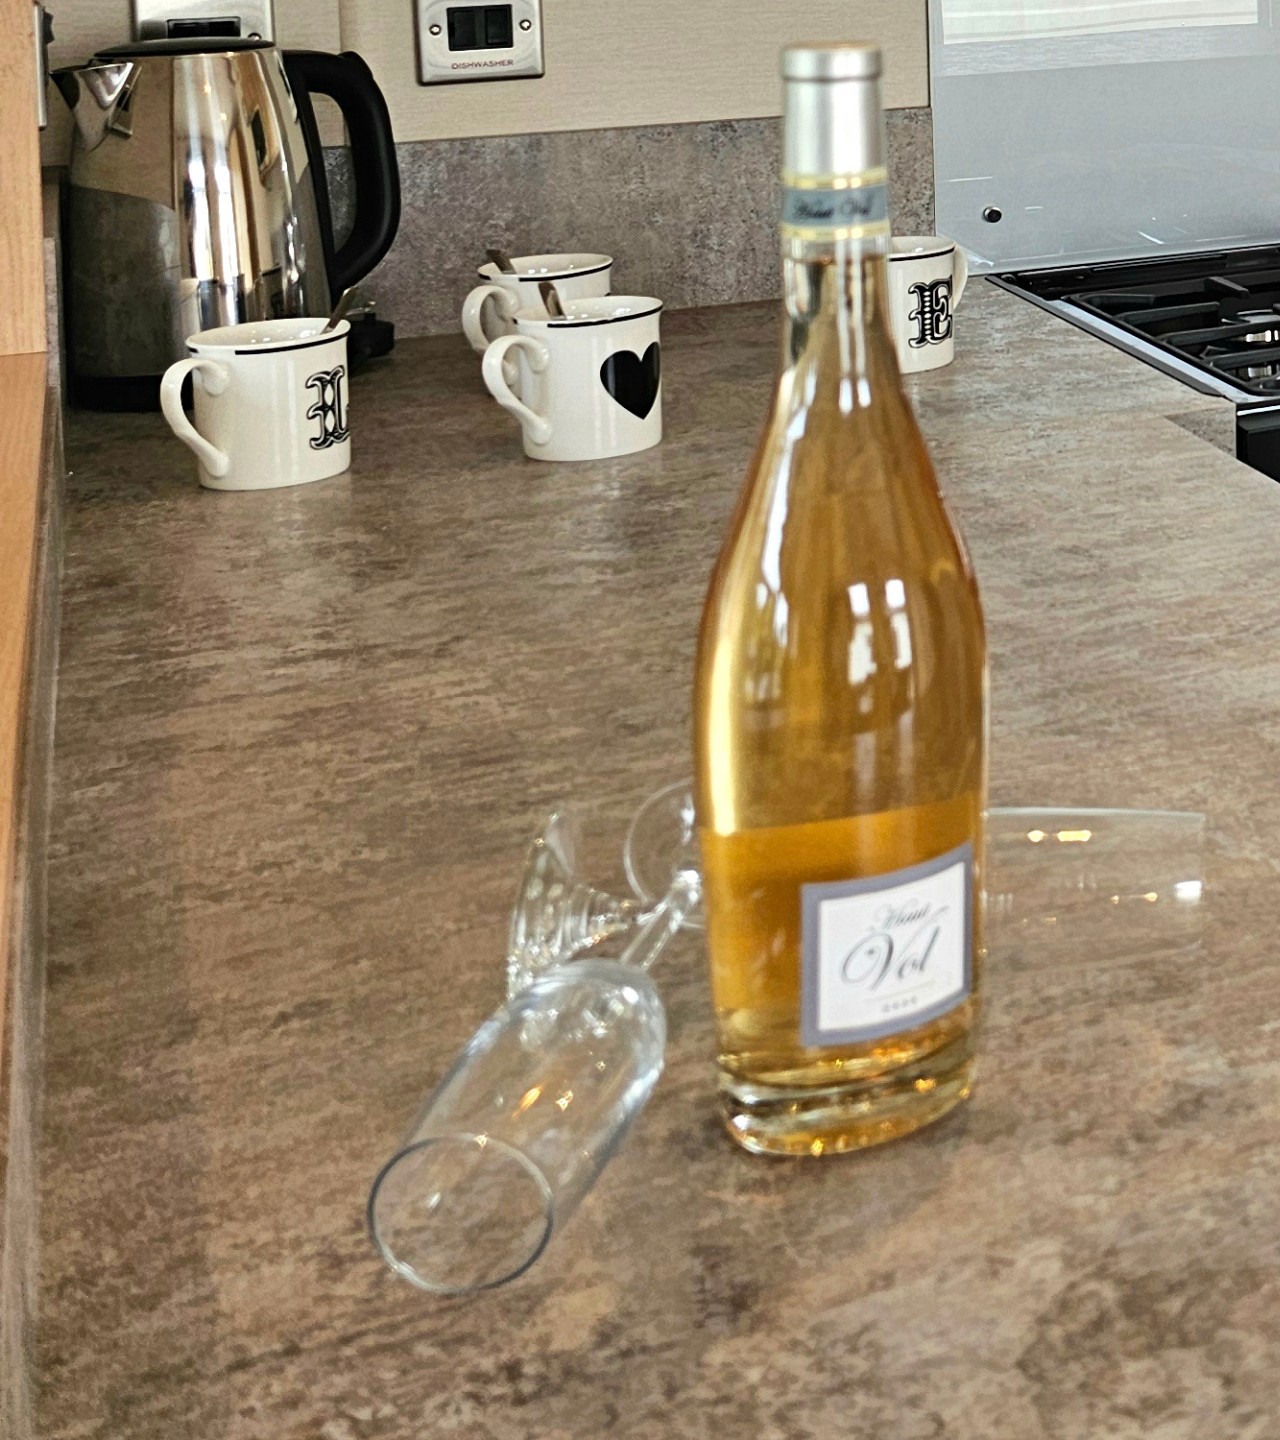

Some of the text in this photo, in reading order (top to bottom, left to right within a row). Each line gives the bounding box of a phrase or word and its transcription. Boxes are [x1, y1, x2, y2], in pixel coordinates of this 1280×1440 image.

[451, 59, 514, 69] DISHWASHER
[908, 274, 953, 348] E
[841, 905, 949, 992] Vol
